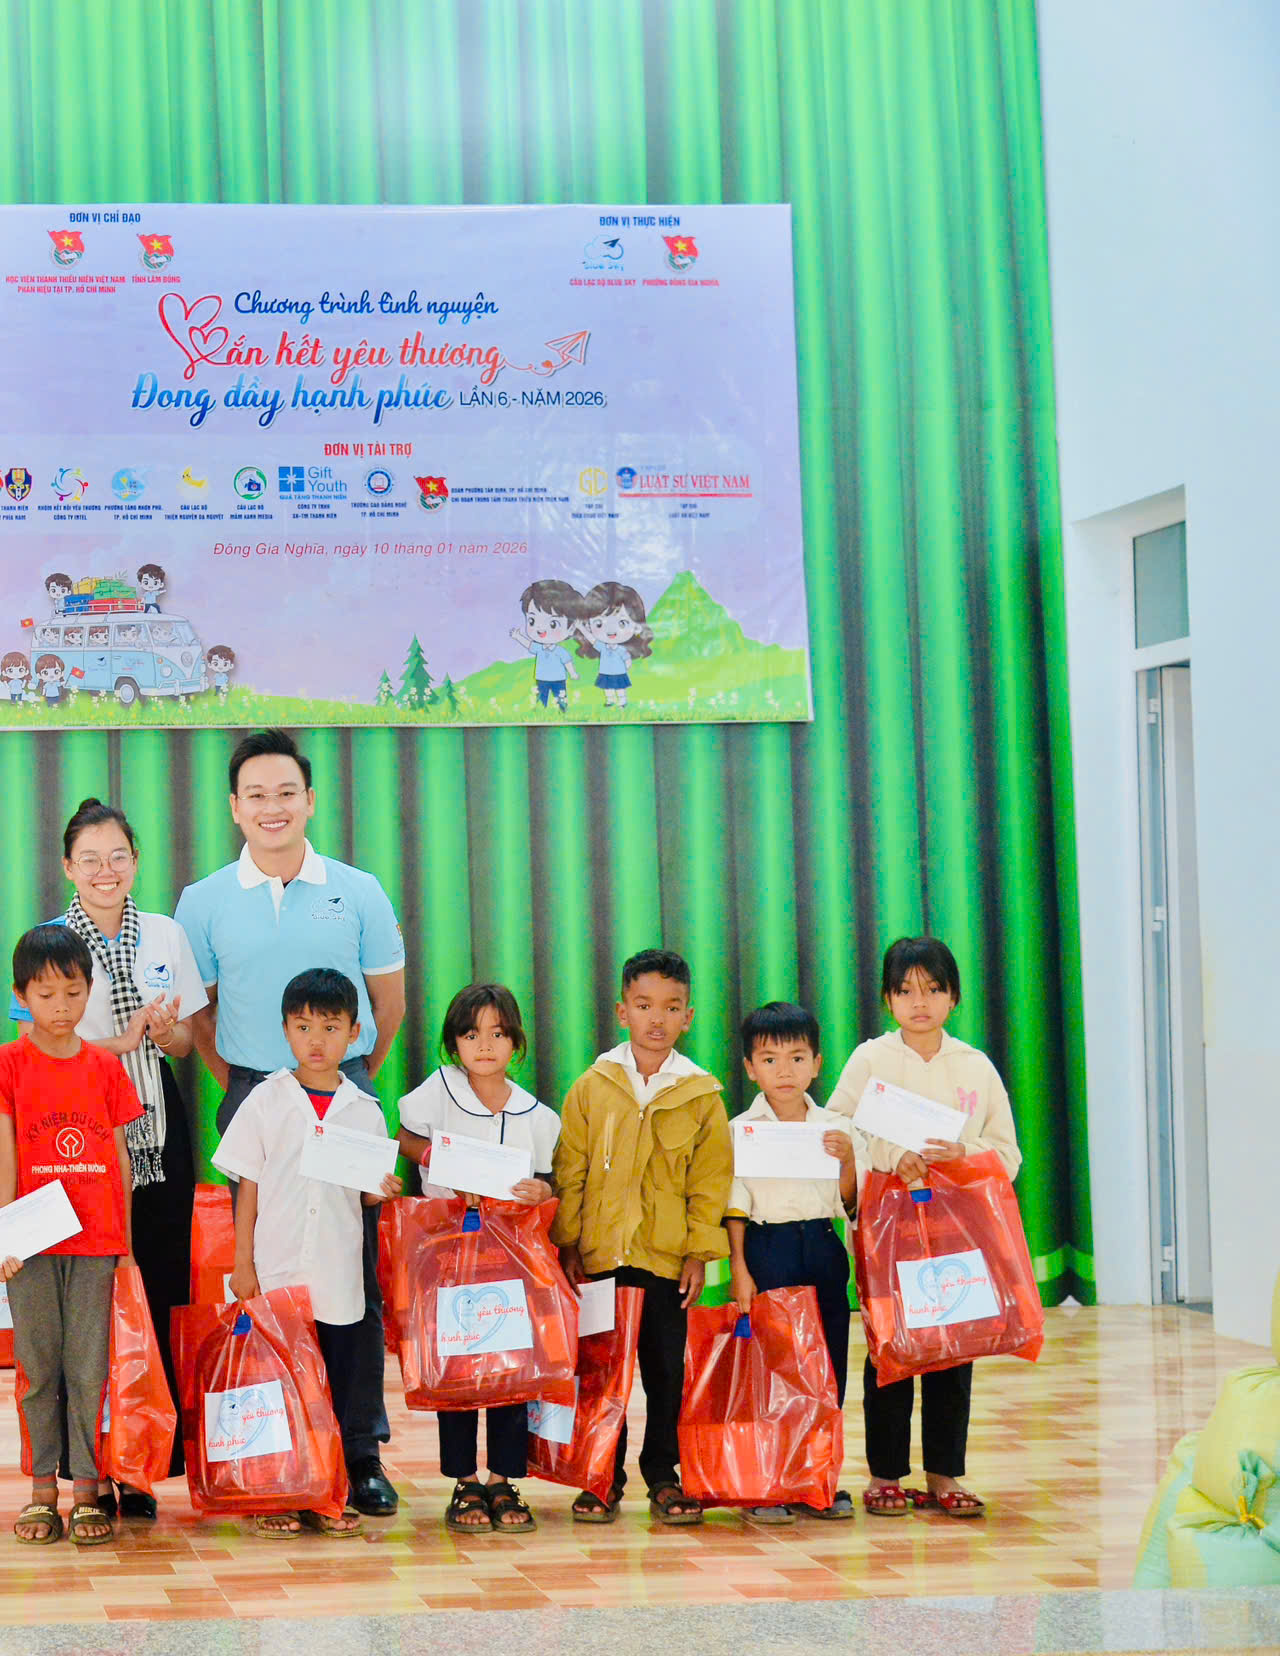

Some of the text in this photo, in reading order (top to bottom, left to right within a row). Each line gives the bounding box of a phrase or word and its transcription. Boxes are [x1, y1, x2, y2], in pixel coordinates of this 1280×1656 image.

[70, 210, 141, 225] ĐƠN VỊ CHỈ ĐẠO
[600, 215, 680, 229] ĐƠN VỊ THỰC HIỆN
[234, 290, 498, 325] Chương trình tình nguyện
[275, 331, 324, 367] kết
[330, 339, 392, 385] yêu
[399, 331, 505, 385] thương
[131, 372, 217, 429] Đong
[224, 373, 284, 428] đầy
[291, 373, 372, 414] hạnh
[373, 374, 453, 425] phúc
[460, 386, 493, 406] LẦN
[498, 391, 509, 406] 6
[522, 387, 561, 406] NĂM
[565, 391, 604, 406] 2026
[324, 442, 412, 459] ĐƠN VỊ TÀI TRỢ
[308, 466, 332, 479] Gift
[308, 480, 348, 493] Youth
[640, 473, 750, 489] LUẬT SƯ VIỆT NAM
[255, 543, 279, 555] Gia
[374, 543, 389, 554] 10
[437, 543, 453, 554] 01
[492, 542, 528, 554] 2026
[31, 1165, 53, 1174] PHONG
